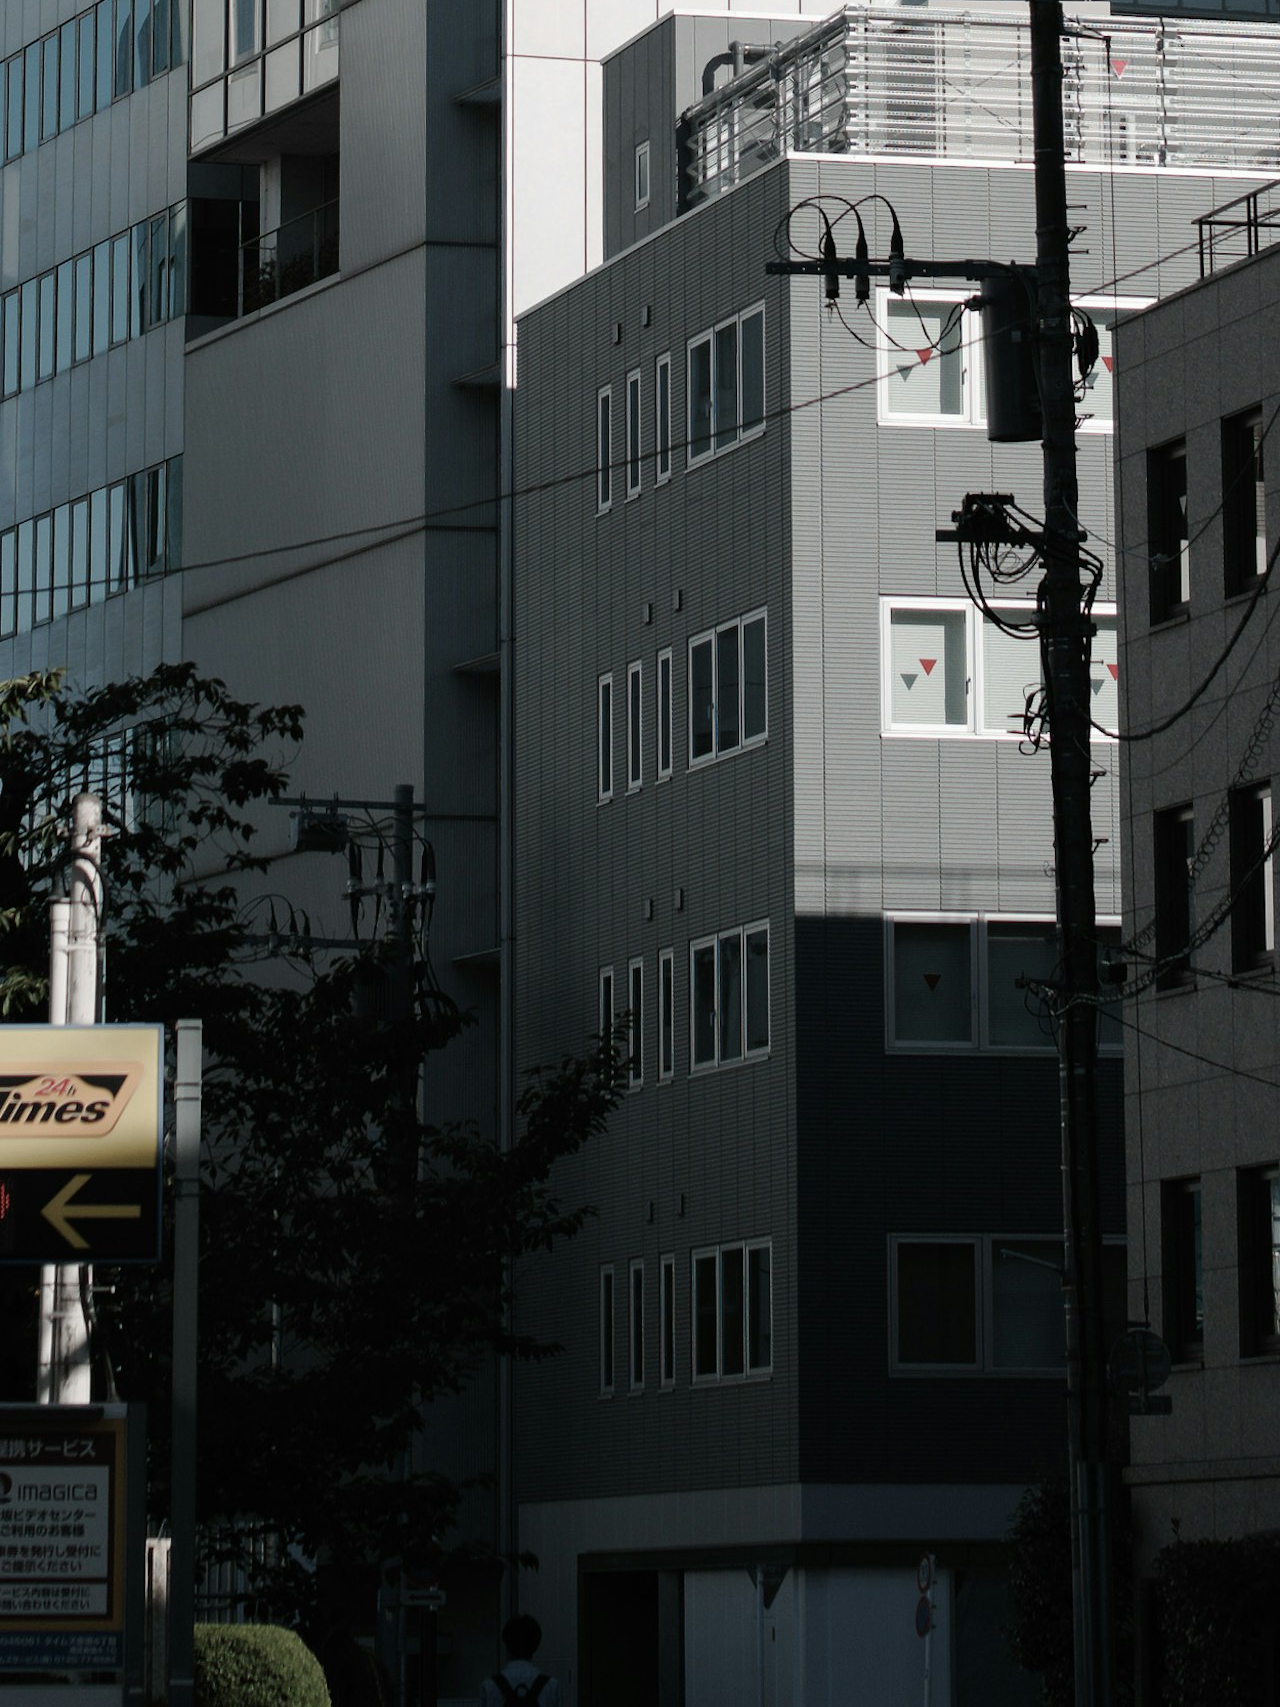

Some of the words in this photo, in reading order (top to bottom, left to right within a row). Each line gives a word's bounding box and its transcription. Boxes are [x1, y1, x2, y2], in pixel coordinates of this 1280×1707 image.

[34, 1077, 77, 1097] 24h
[0, 1524, 85, 1538] ご利用のお客様
[1, 1559, 82, 1574] ご提示ください
